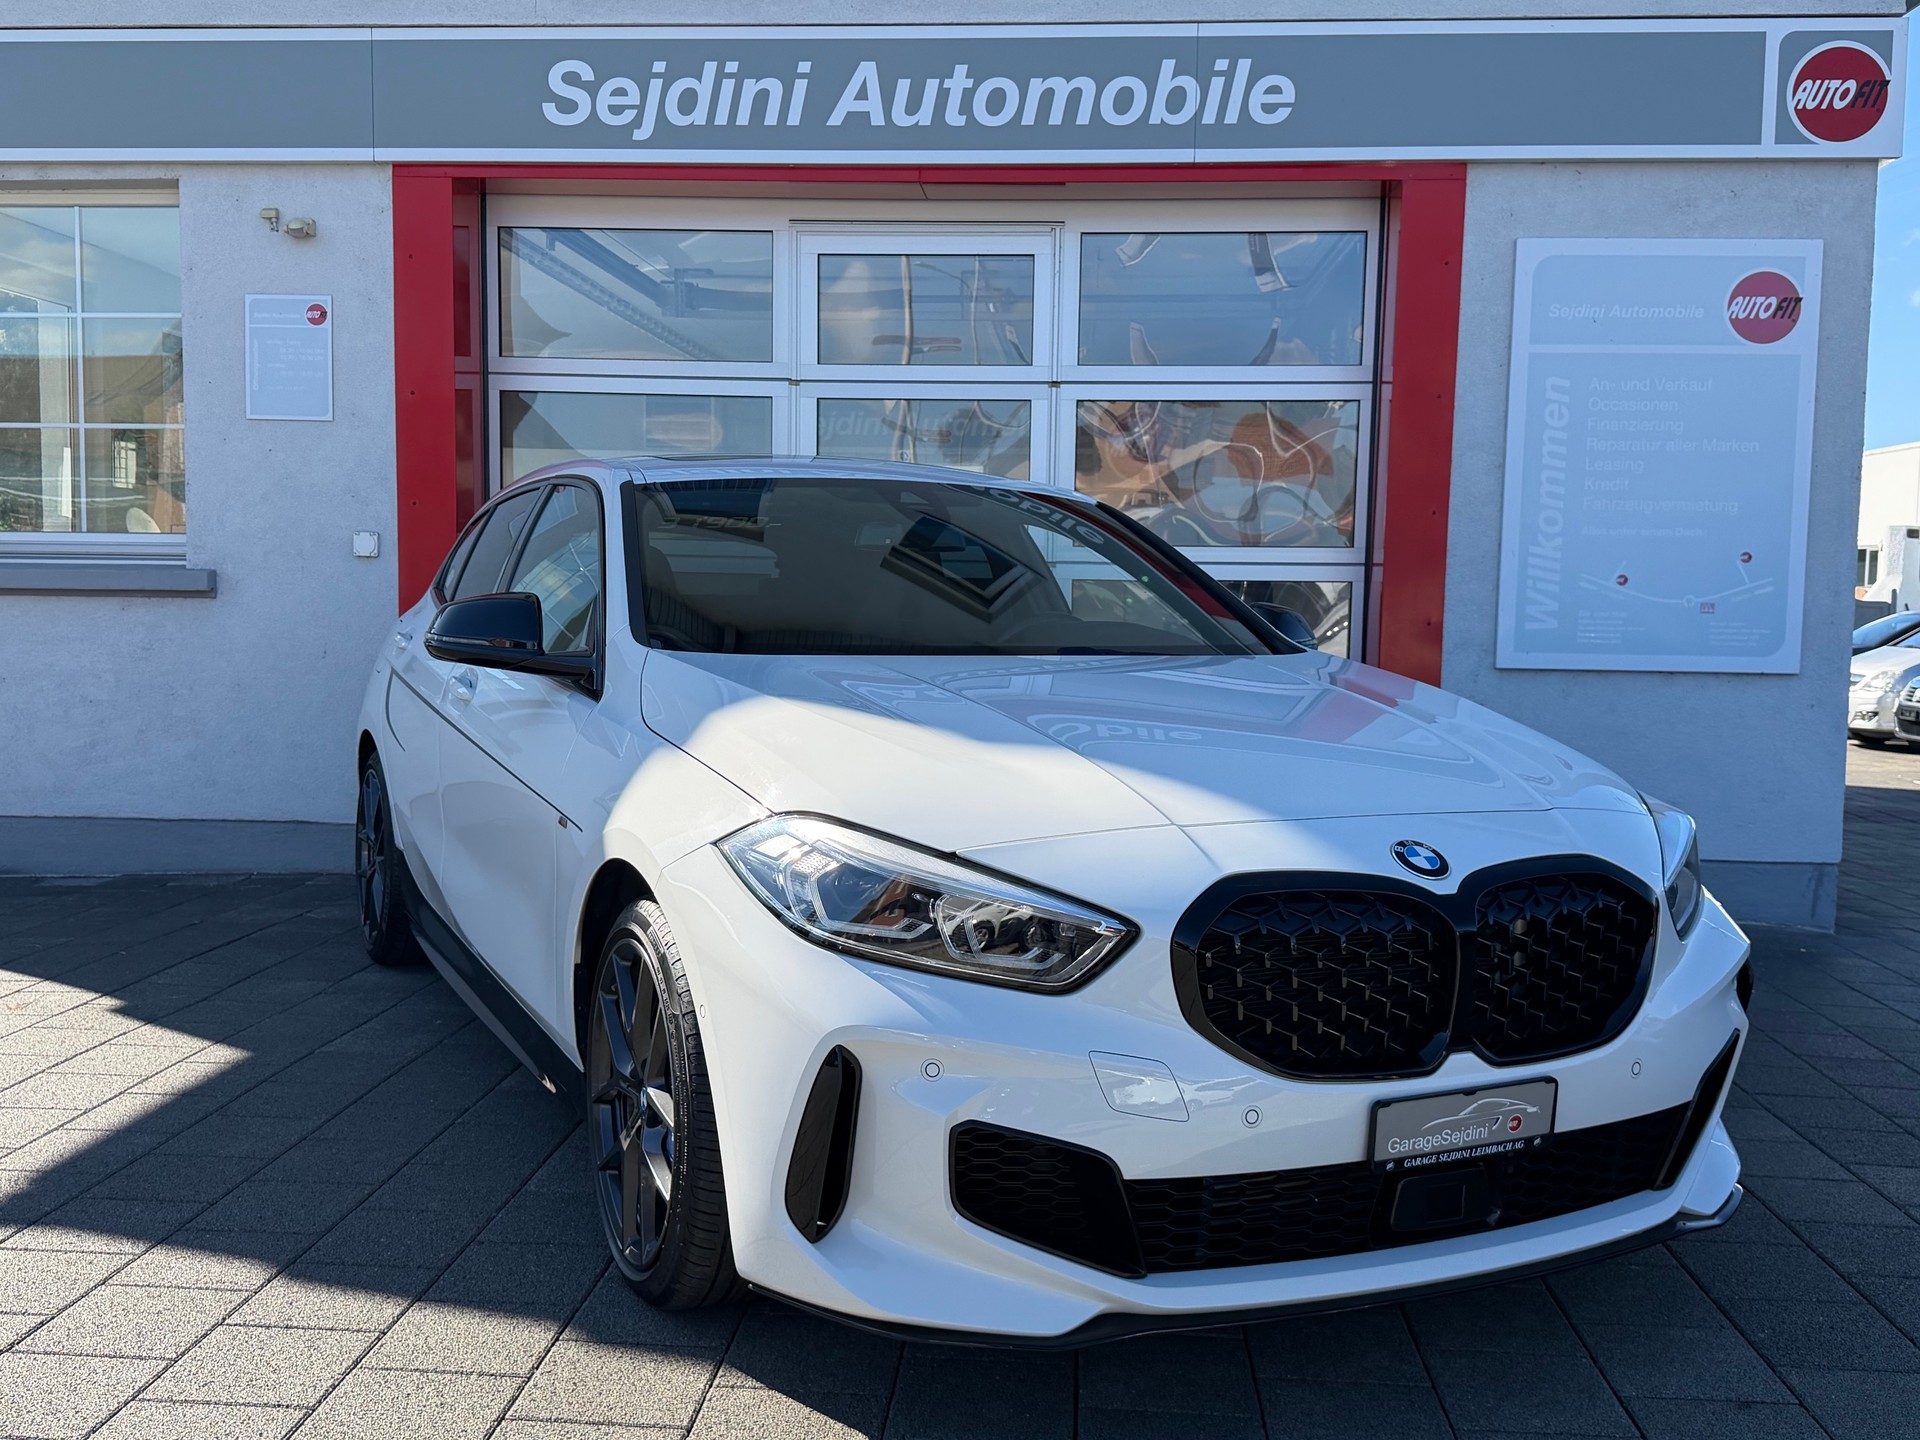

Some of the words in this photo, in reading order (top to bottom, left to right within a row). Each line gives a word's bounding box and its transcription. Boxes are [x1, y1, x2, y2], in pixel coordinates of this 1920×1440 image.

[541, 59, 812, 141] Sejdini
[827, 58, 1296, 128] Automobile
[1792, 79, 1891, 110] AUTOFIT
[1549, 303, 1605, 321] Sejdini
[1609, 303, 1705, 319] Automobile
[1727, 296, 1804, 320] AUTOFIT
[1621, 378, 1650, 392] und
[1654, 377, 1714, 392] Verkauf
[1588, 397, 1679, 412] Occasionen
[1587, 417, 1684, 435] Finanzierung
[1586, 437, 1662, 454] Reparatur
[1665, 438, 1698, 452] aller
[1702, 438, 1760, 452] Marken
[1585, 457, 1645, 474] Leasing
[1584, 477, 1630, 491] Kredit
[1525, 376, 1571, 630] Willkommen
[1583, 497, 1739, 515] Fahrzeugvermietung
[1387, 1123, 1489, 1153] GarageSejdini
[1403, 1154, 1437, 1168] GARAGE
[1438, 1149, 1470, 1162] SEJDINI
[1471, 1142, 1513, 1156] LEIMBACH
[1513, 1140, 1525, 1150] AG
